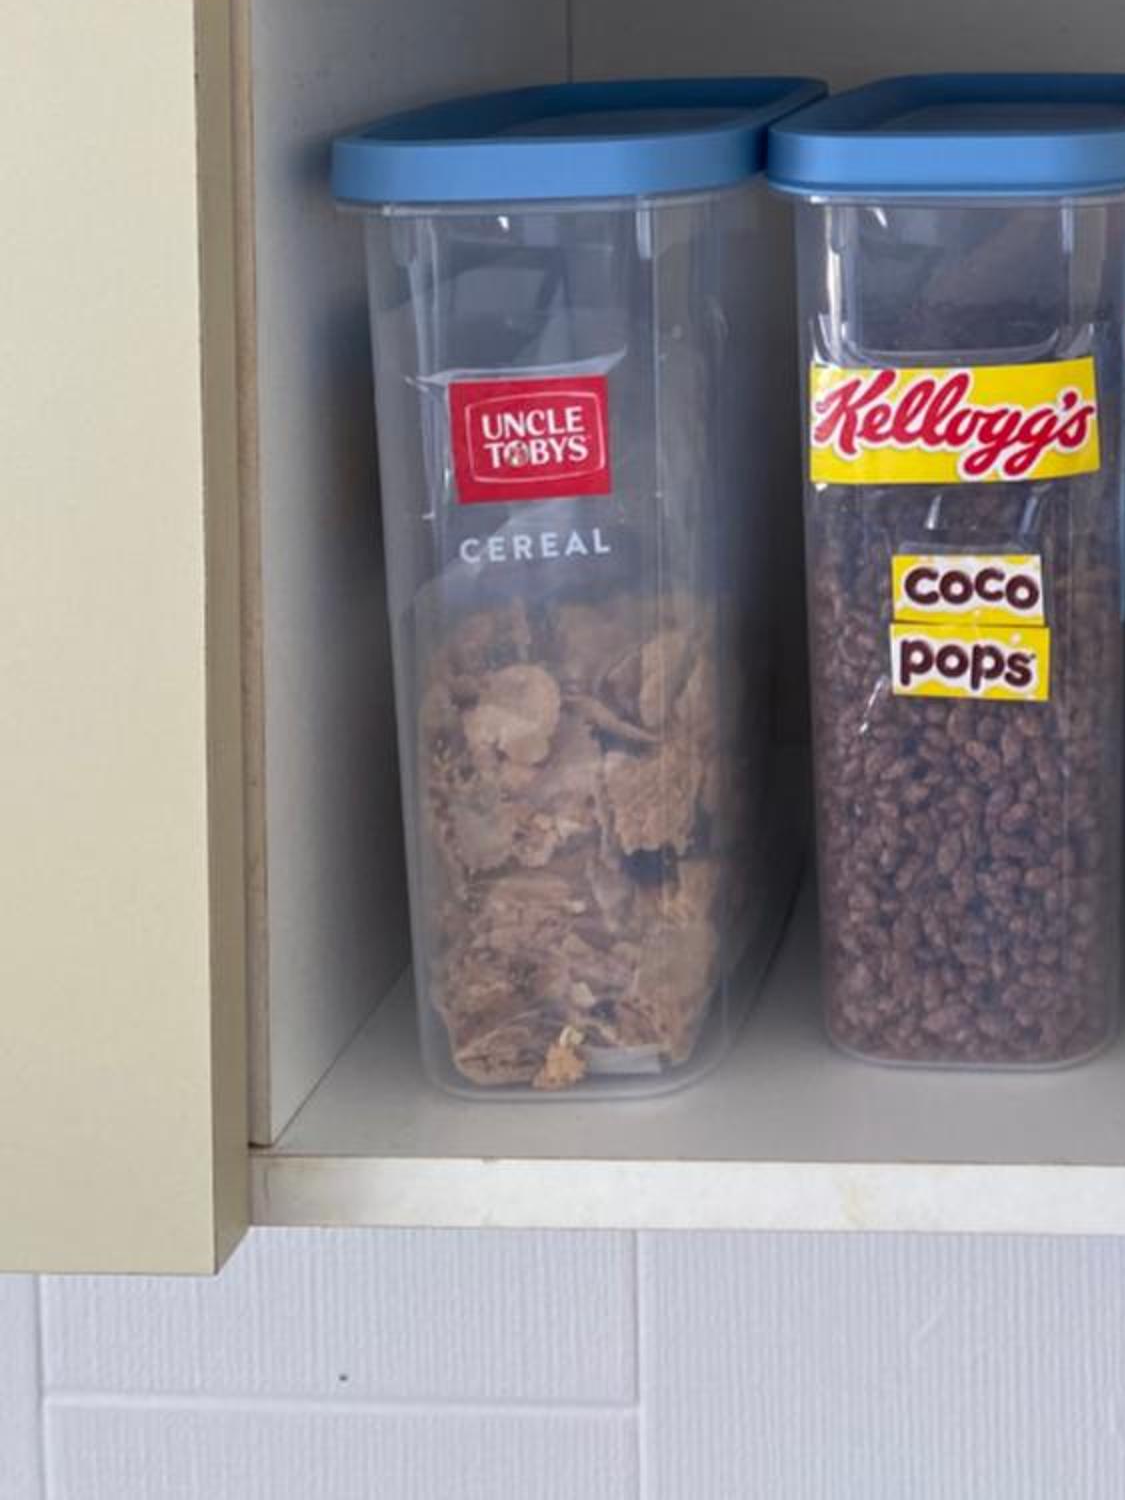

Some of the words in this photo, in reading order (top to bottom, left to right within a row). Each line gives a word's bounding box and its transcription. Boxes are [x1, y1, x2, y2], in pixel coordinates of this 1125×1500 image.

[481, 406, 585, 440] UNCLE
[814, 370, 1095, 477] Kellogg's
[484, 436, 590, 469] TOBYS
[459, 528, 612, 564] CEREAL
[903, 567, 1040, 610] coco
[898, 638, 1036, 690] pops
